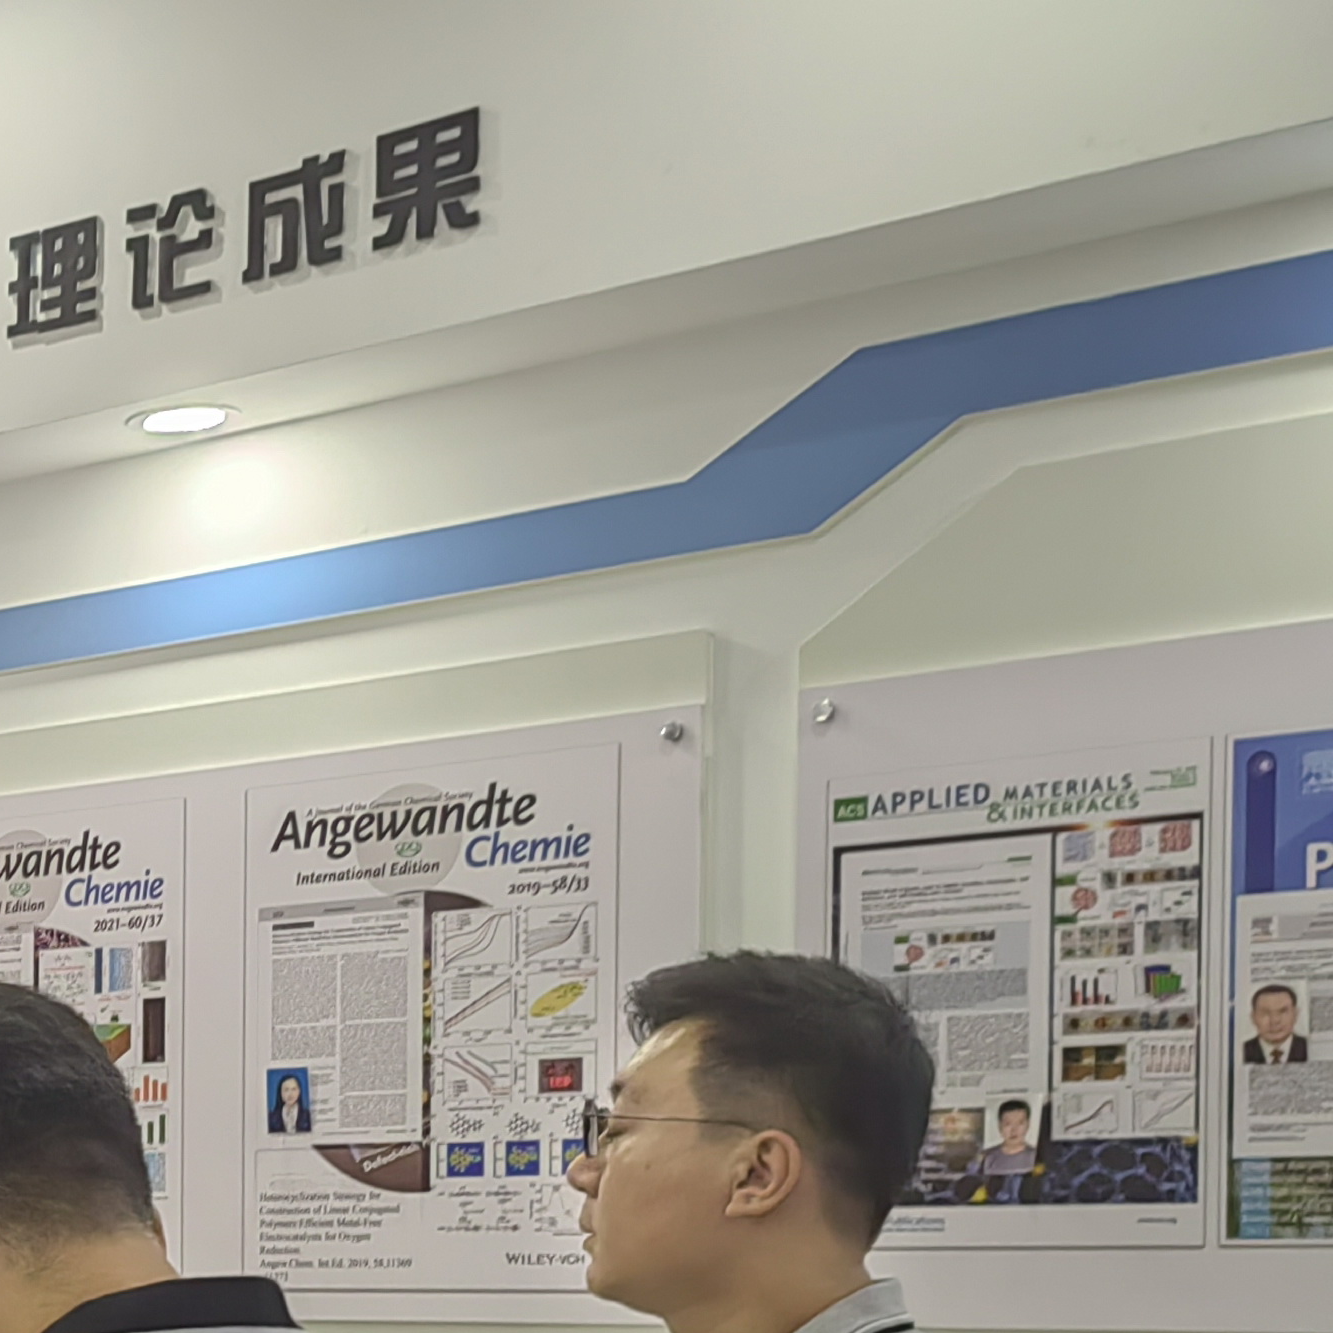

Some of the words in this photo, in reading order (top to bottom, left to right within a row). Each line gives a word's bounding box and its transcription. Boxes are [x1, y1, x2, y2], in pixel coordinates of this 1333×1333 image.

[5, 106, 481, 339] 理论成果
[836, 803, 866, 819] ACS
[871, 782, 991, 817] APPLIED
[1002, 772, 1134, 802] MATERIALS
[986, 803, 1008, 823] &
[1012, 790, 1142, 822] INTERFACES
[270, 781, 537, 861] Angewandte
[464, 823, 592, 869] Chemie
[64, 868, 165, 908] Chemie
[296, 862, 386, 887] International
[389, 859, 441, 877] Edition
[5, 899, 46, 915] Edition
[505, 1252, 586, 1266] WILEY-VCH
